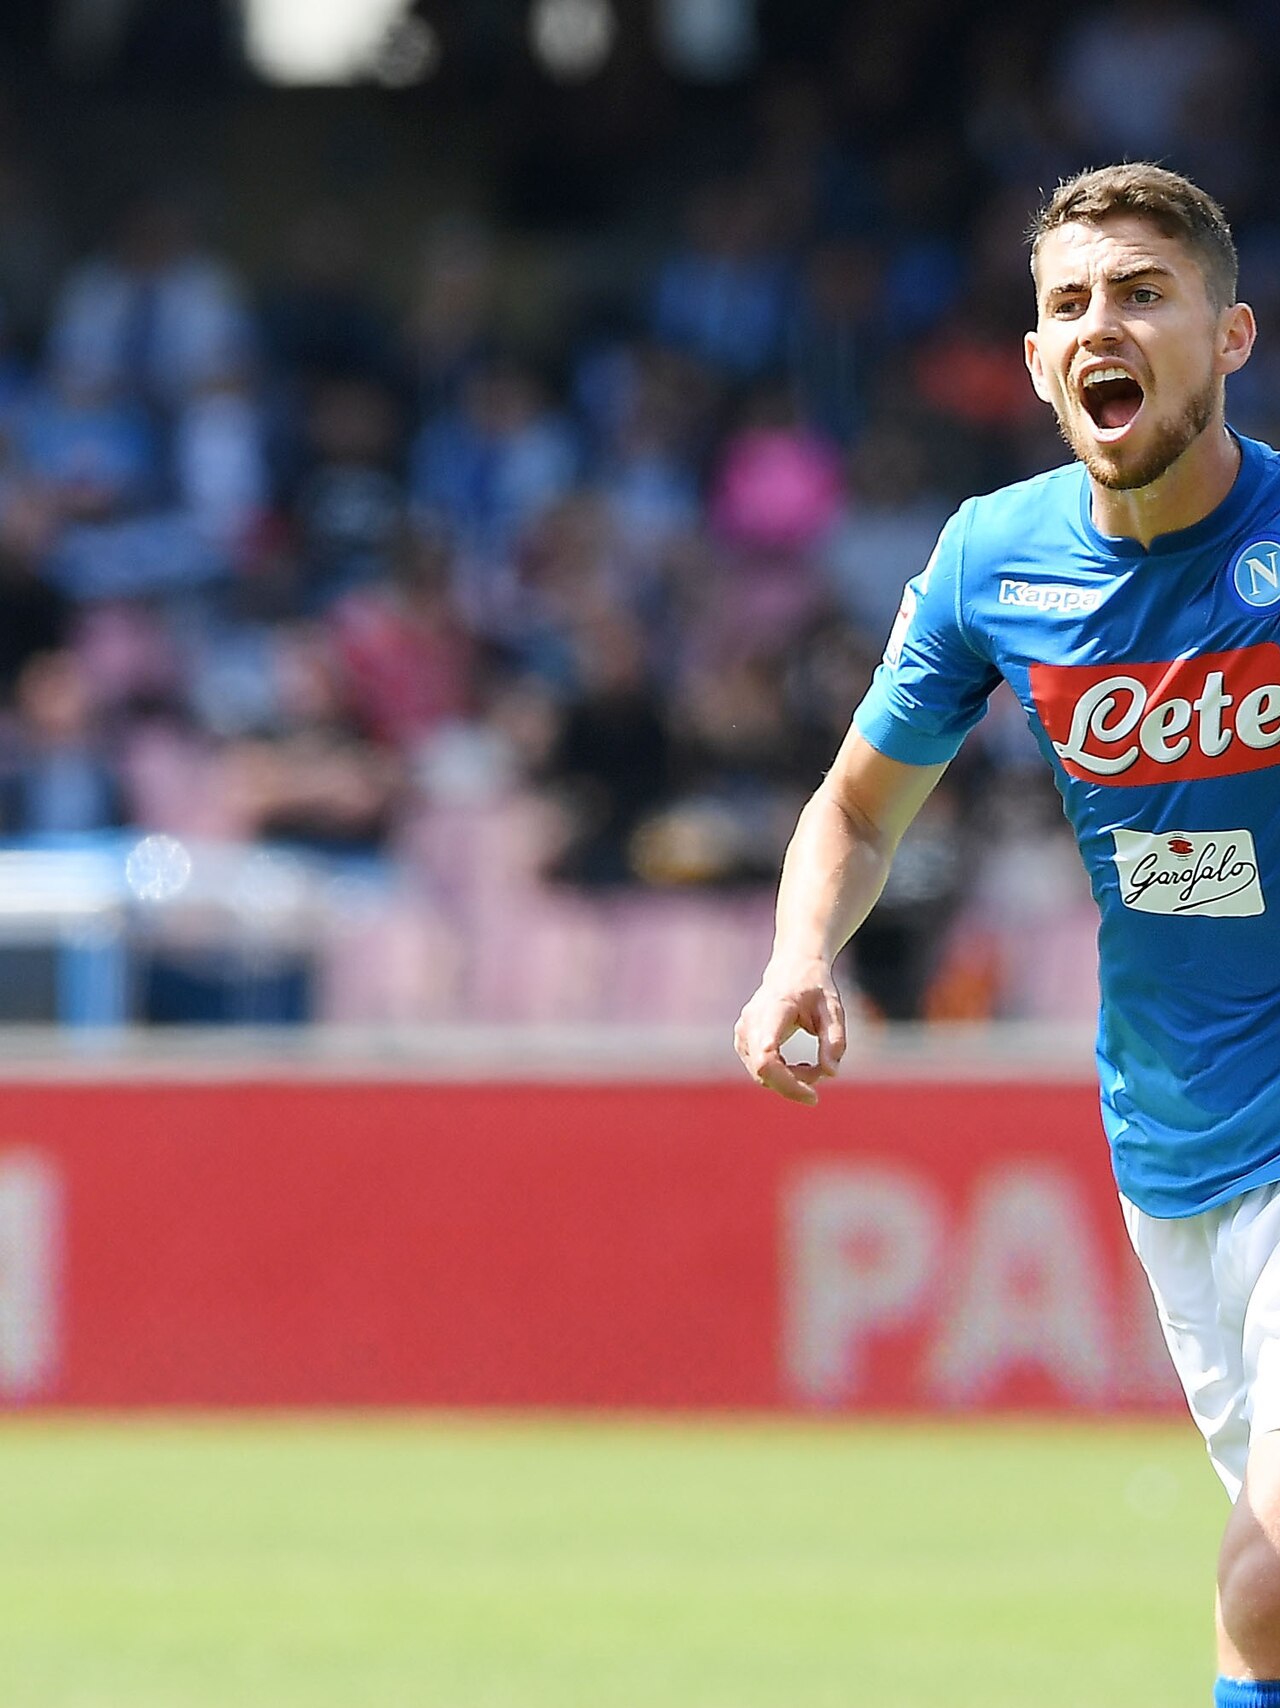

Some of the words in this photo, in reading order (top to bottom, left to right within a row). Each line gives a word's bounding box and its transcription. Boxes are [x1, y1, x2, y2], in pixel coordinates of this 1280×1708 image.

[1000, 581, 1101, 610] Kappa
[1244, 551, 1278, 596] N
[1125, 843, 1256, 912] Garofalo
